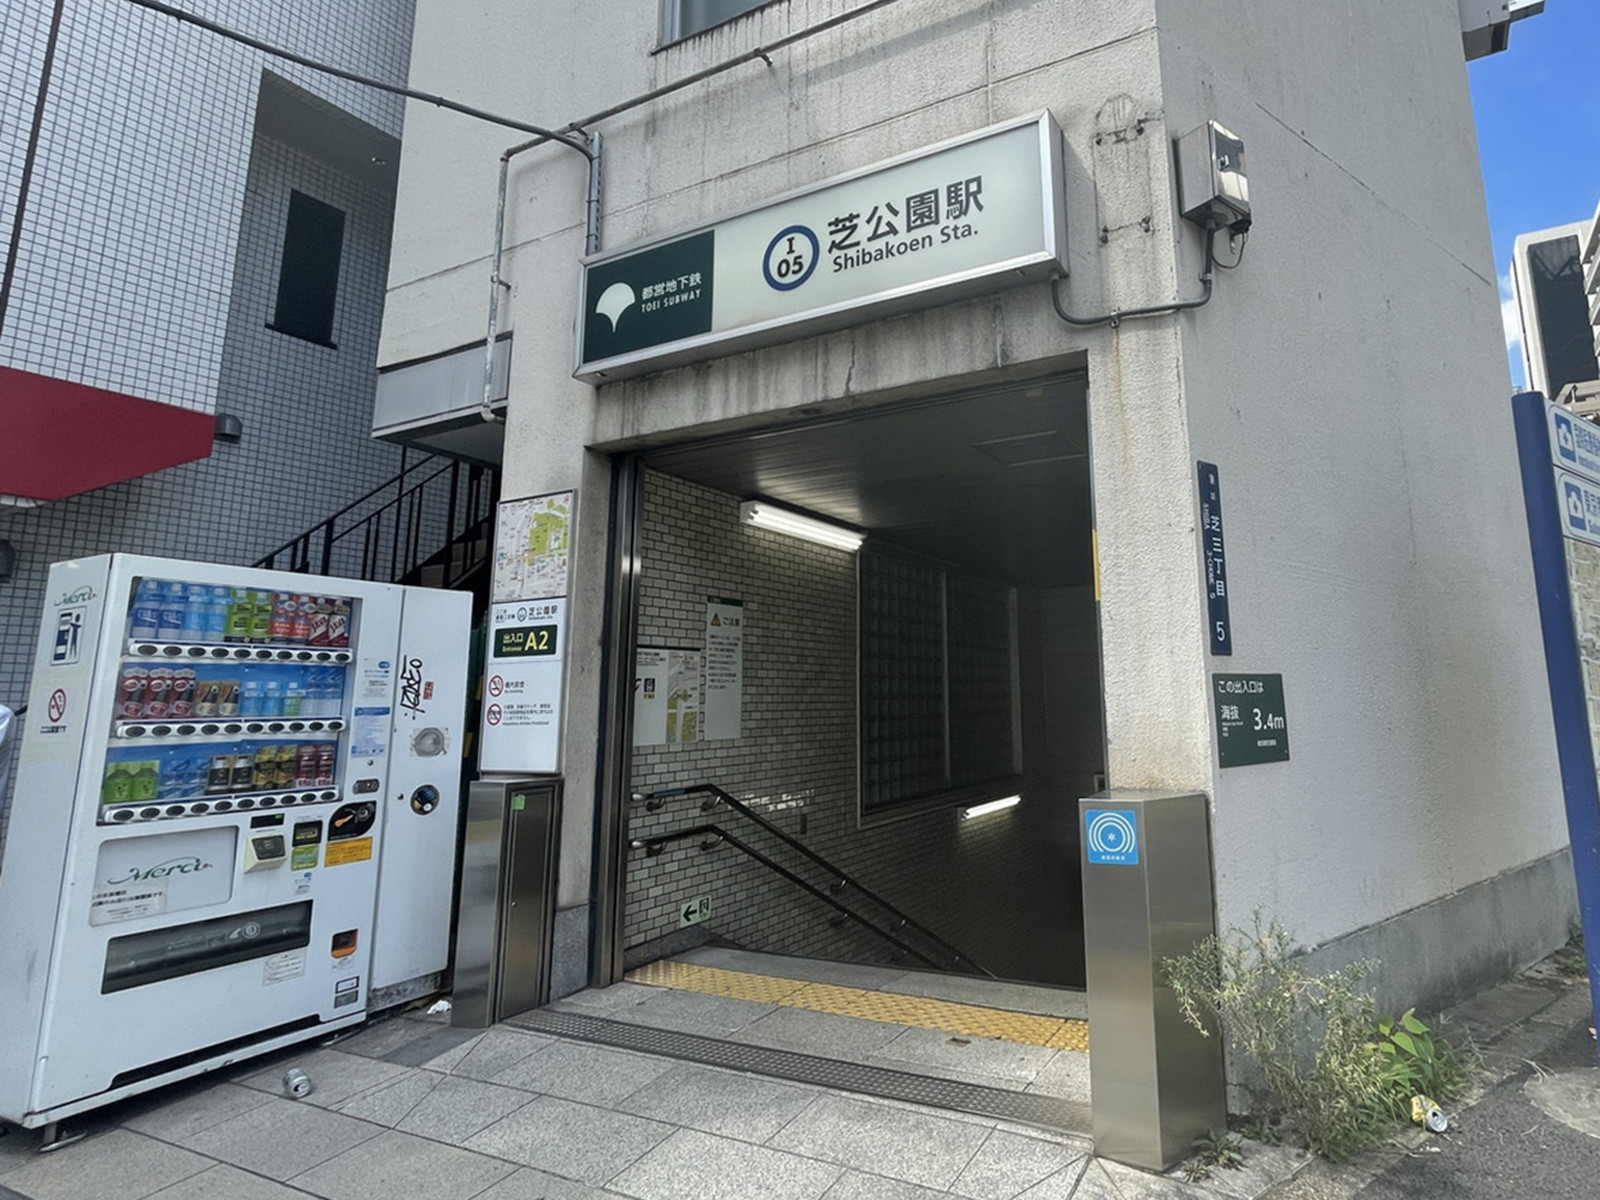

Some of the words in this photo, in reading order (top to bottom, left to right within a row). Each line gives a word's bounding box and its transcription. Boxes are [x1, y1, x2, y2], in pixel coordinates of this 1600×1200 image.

[827, 175, 984, 254] 芝公園駅
[786, 237, 795, 254] I
[832, 234, 933, 273] Shibakoen
[940, 223, 979, 243] Sta.
[777, 255, 804, 278] 05
[641, 272, 702, 300] 都営地下鉄
[641, 300, 661, 313] TOEI
[663, 289, 702, 307] SUBWAY
[502, 633, 524, 644] 出入口
[524, 630, 549, 651] A2
[1216, 621, 1226, 642] 5
[1218, 680, 1264, 694] この出入口は
[1220, 704, 1240, 720] 海抜
[1252, 708, 1285, 731] 3.4m
[107, 856, 206, 885] Merci
